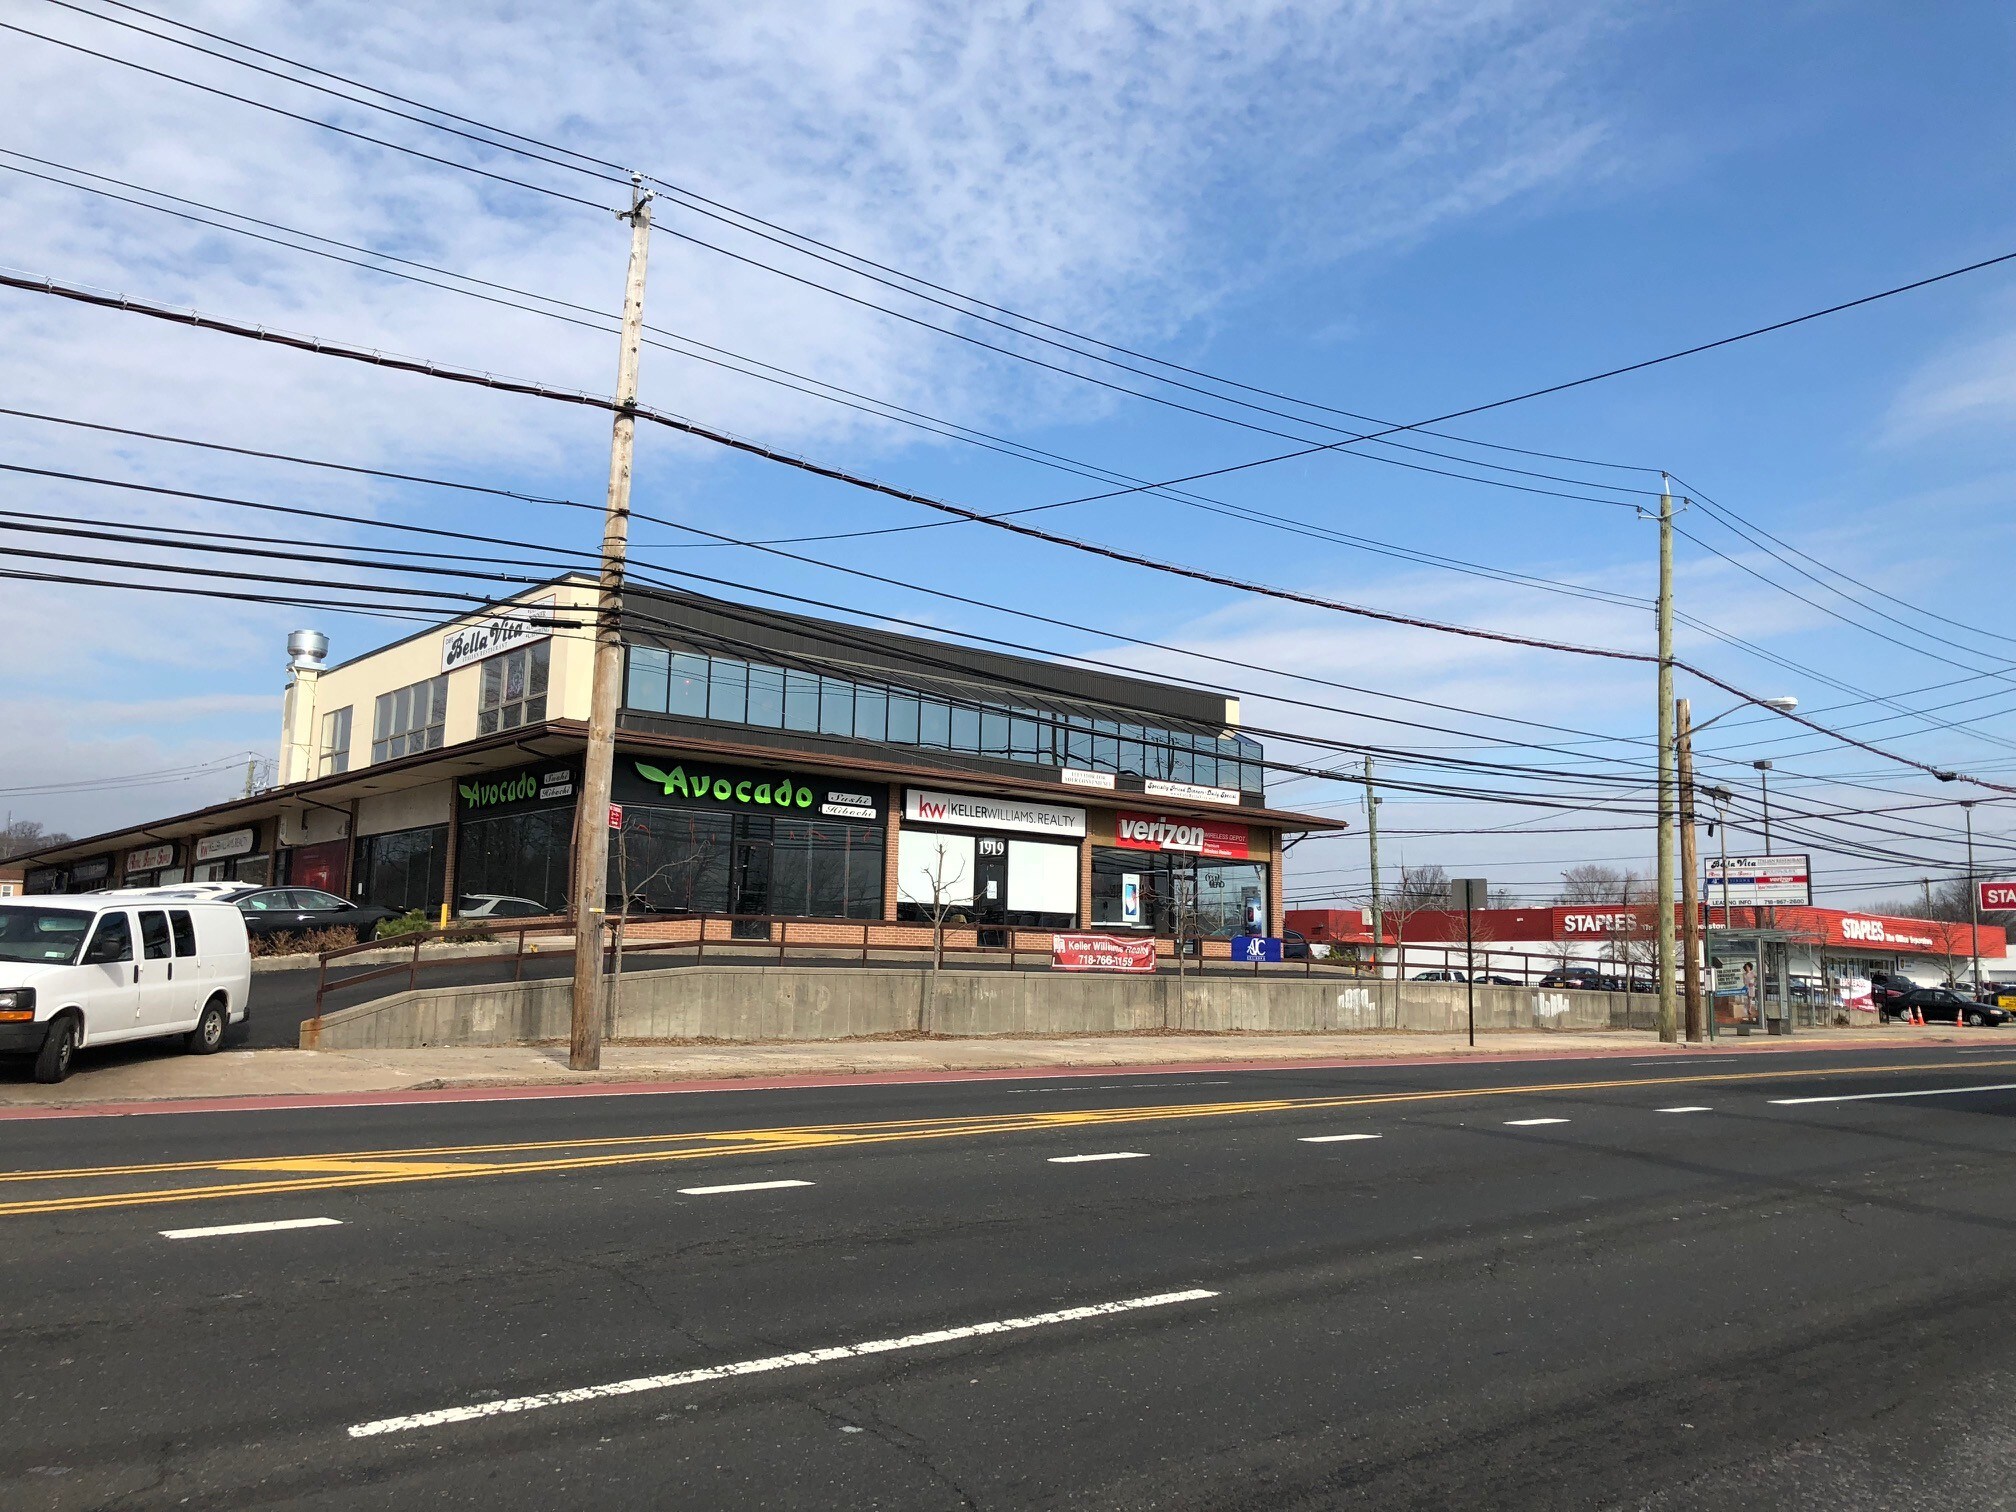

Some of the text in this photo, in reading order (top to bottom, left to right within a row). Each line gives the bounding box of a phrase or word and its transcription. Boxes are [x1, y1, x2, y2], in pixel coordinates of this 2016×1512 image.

[446, 619, 523, 666] Bella Vita
[468, 771, 537, 809] Avocado
[662, 765, 813, 808] Avocado
[829, 792, 870, 805] Sushi
[824, 804, 874, 818] Hibachi
[1038, 812, 1076, 828] REALTY
[1118, 816, 1204, 852] verizon
[1204, 832, 1246, 842] WIRELESS DEPOT
[978, 840, 1005, 856] 1919
[1736, 858, 1757, 867] Vita
[1564, 913, 1637, 932] STAPLES
[1841, 917, 1885, 942] STAPLES
[1068, 941, 1091, 951] Keller
[1079, 954, 1134, 967] 718-766-1159
